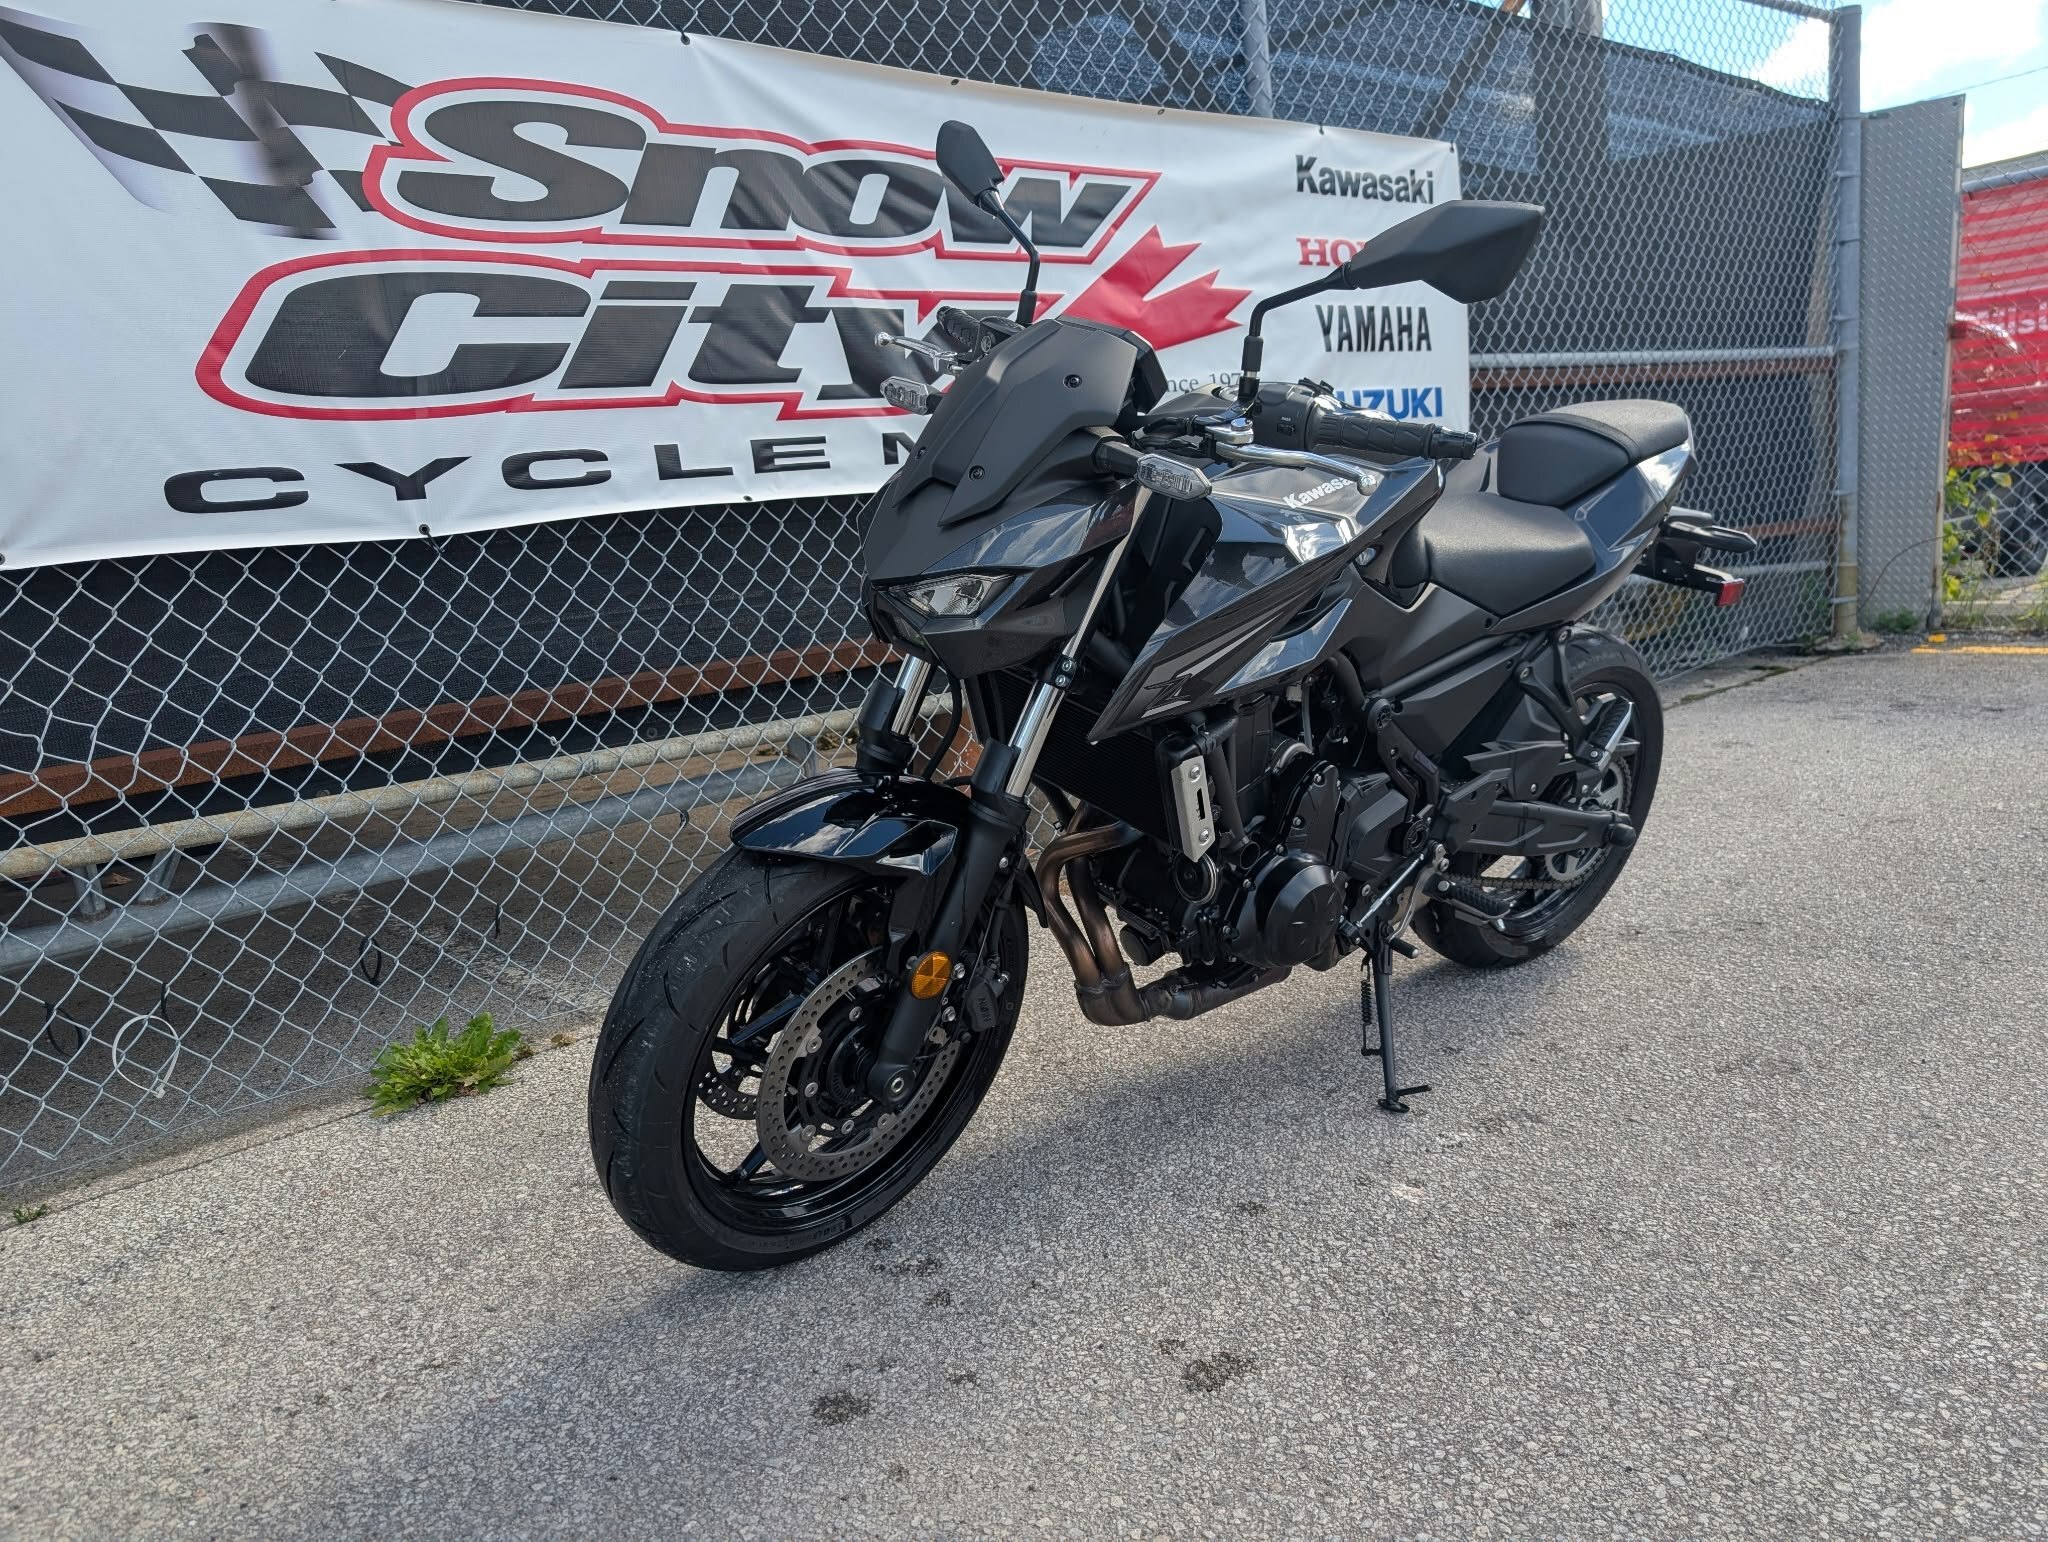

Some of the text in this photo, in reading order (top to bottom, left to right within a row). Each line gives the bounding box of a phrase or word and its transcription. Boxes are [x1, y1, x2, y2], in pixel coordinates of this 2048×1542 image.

[396, 100, 1134, 248] Snow
[1296, 154, 1434, 204] Kawasaki
[244, 271, 1016, 400] City
[1314, 304, 1432, 353] YAMAHA
[1335, 387, 1443, 420] UZUKI
[163, 435, 830, 514] CYCLE
